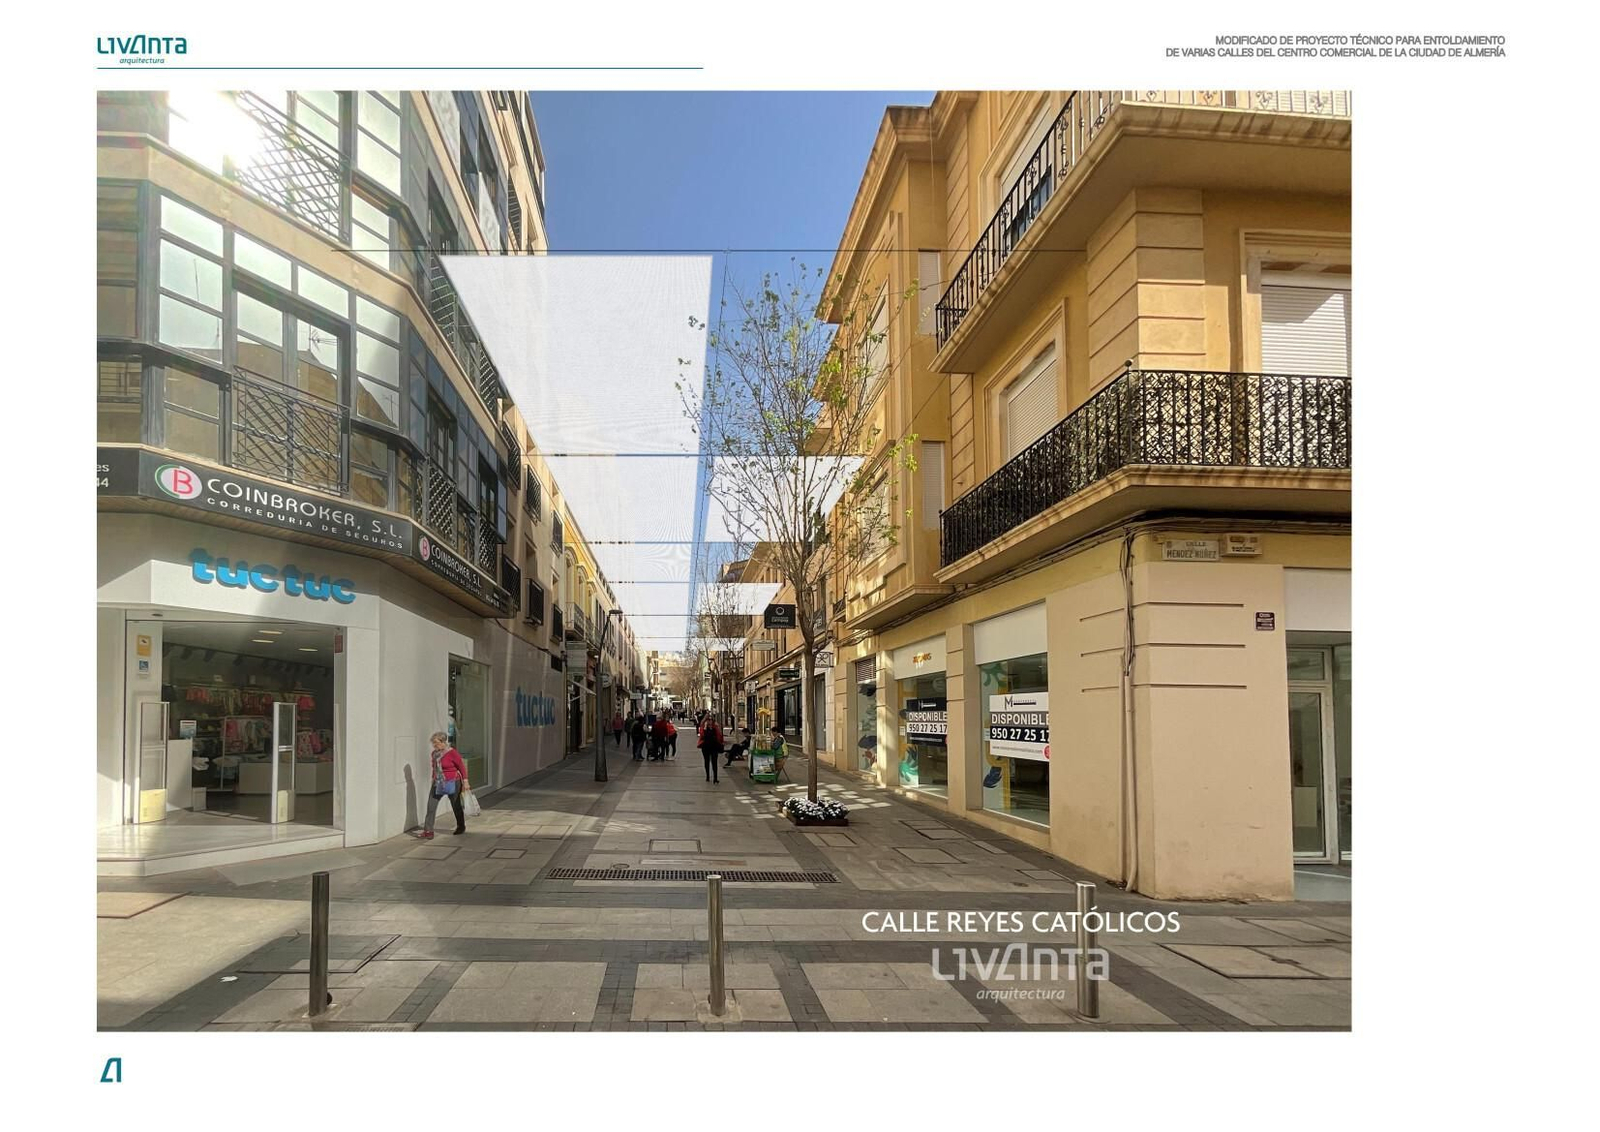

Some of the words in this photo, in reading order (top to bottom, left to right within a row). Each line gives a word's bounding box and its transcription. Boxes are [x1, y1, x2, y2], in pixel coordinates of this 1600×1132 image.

[173, 469, 194, 495] B
[207, 478, 361, 530] COINBROKER,
[371, 519, 403, 539] S.L.
[207, 497, 313, 528] CORREDURIA
[321, 524, 338, 534] DE
[345, 530, 403, 549] SEGUROS
[189, 547, 356, 605] tuctuc
[515, 686, 556, 726] tuctuc
[908, 710, 948, 722] DISPONIBLE
[908, 723, 919, 732] 950
[921, 723, 928, 733] 27
[930, 724, 938, 733] 25
[939, 724, 948, 734] 17
[991, 713, 1049, 726] DISPONIBLE
[991, 727, 1008, 739] 950
[1009, 728, 1021, 740] 27
[1024, 728, 1037, 741] 25
